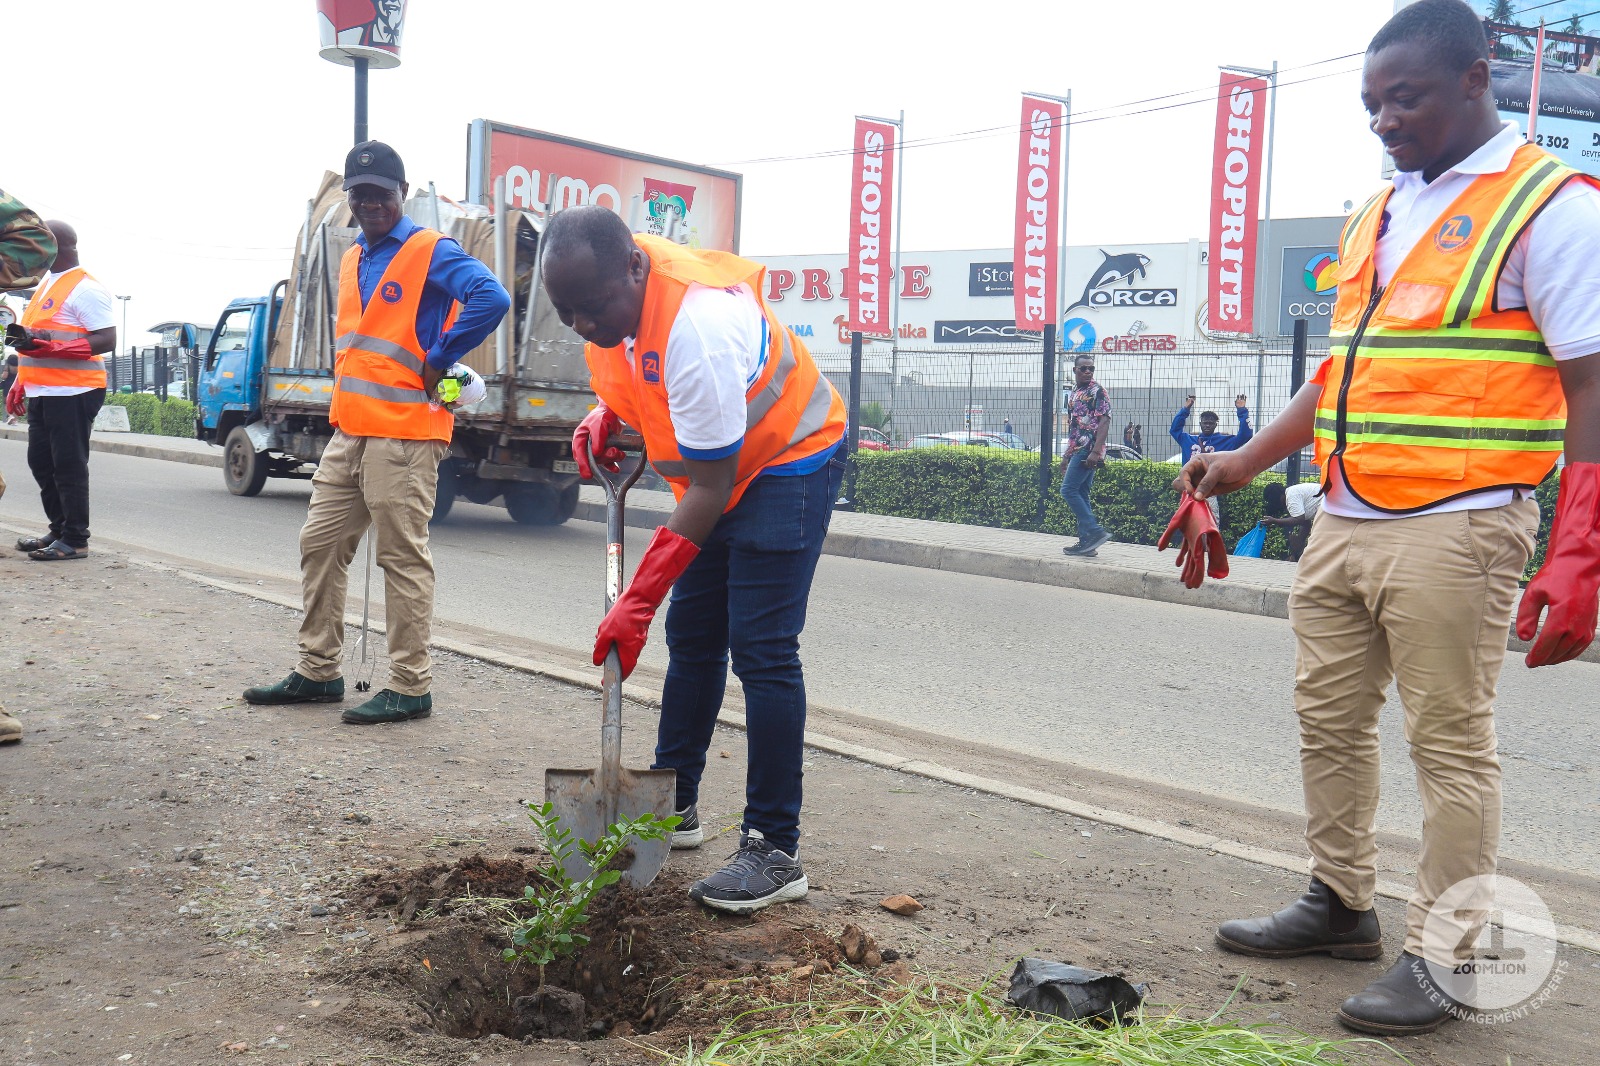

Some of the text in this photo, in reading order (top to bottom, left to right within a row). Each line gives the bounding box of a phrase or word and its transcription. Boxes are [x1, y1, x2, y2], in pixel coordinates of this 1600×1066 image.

[1543, 103, 1565, 113] Central
[1566, 105, 1595, 118] University
[1547, 135, 1570, 150] 302
[857, 130, 885, 324] SHOPRITE
[1024, 108, 1052, 322] SHOPRITE
[1219, 84, 1254, 321] SHOPRITE
[1090, 290, 1176, 305] ORCA
